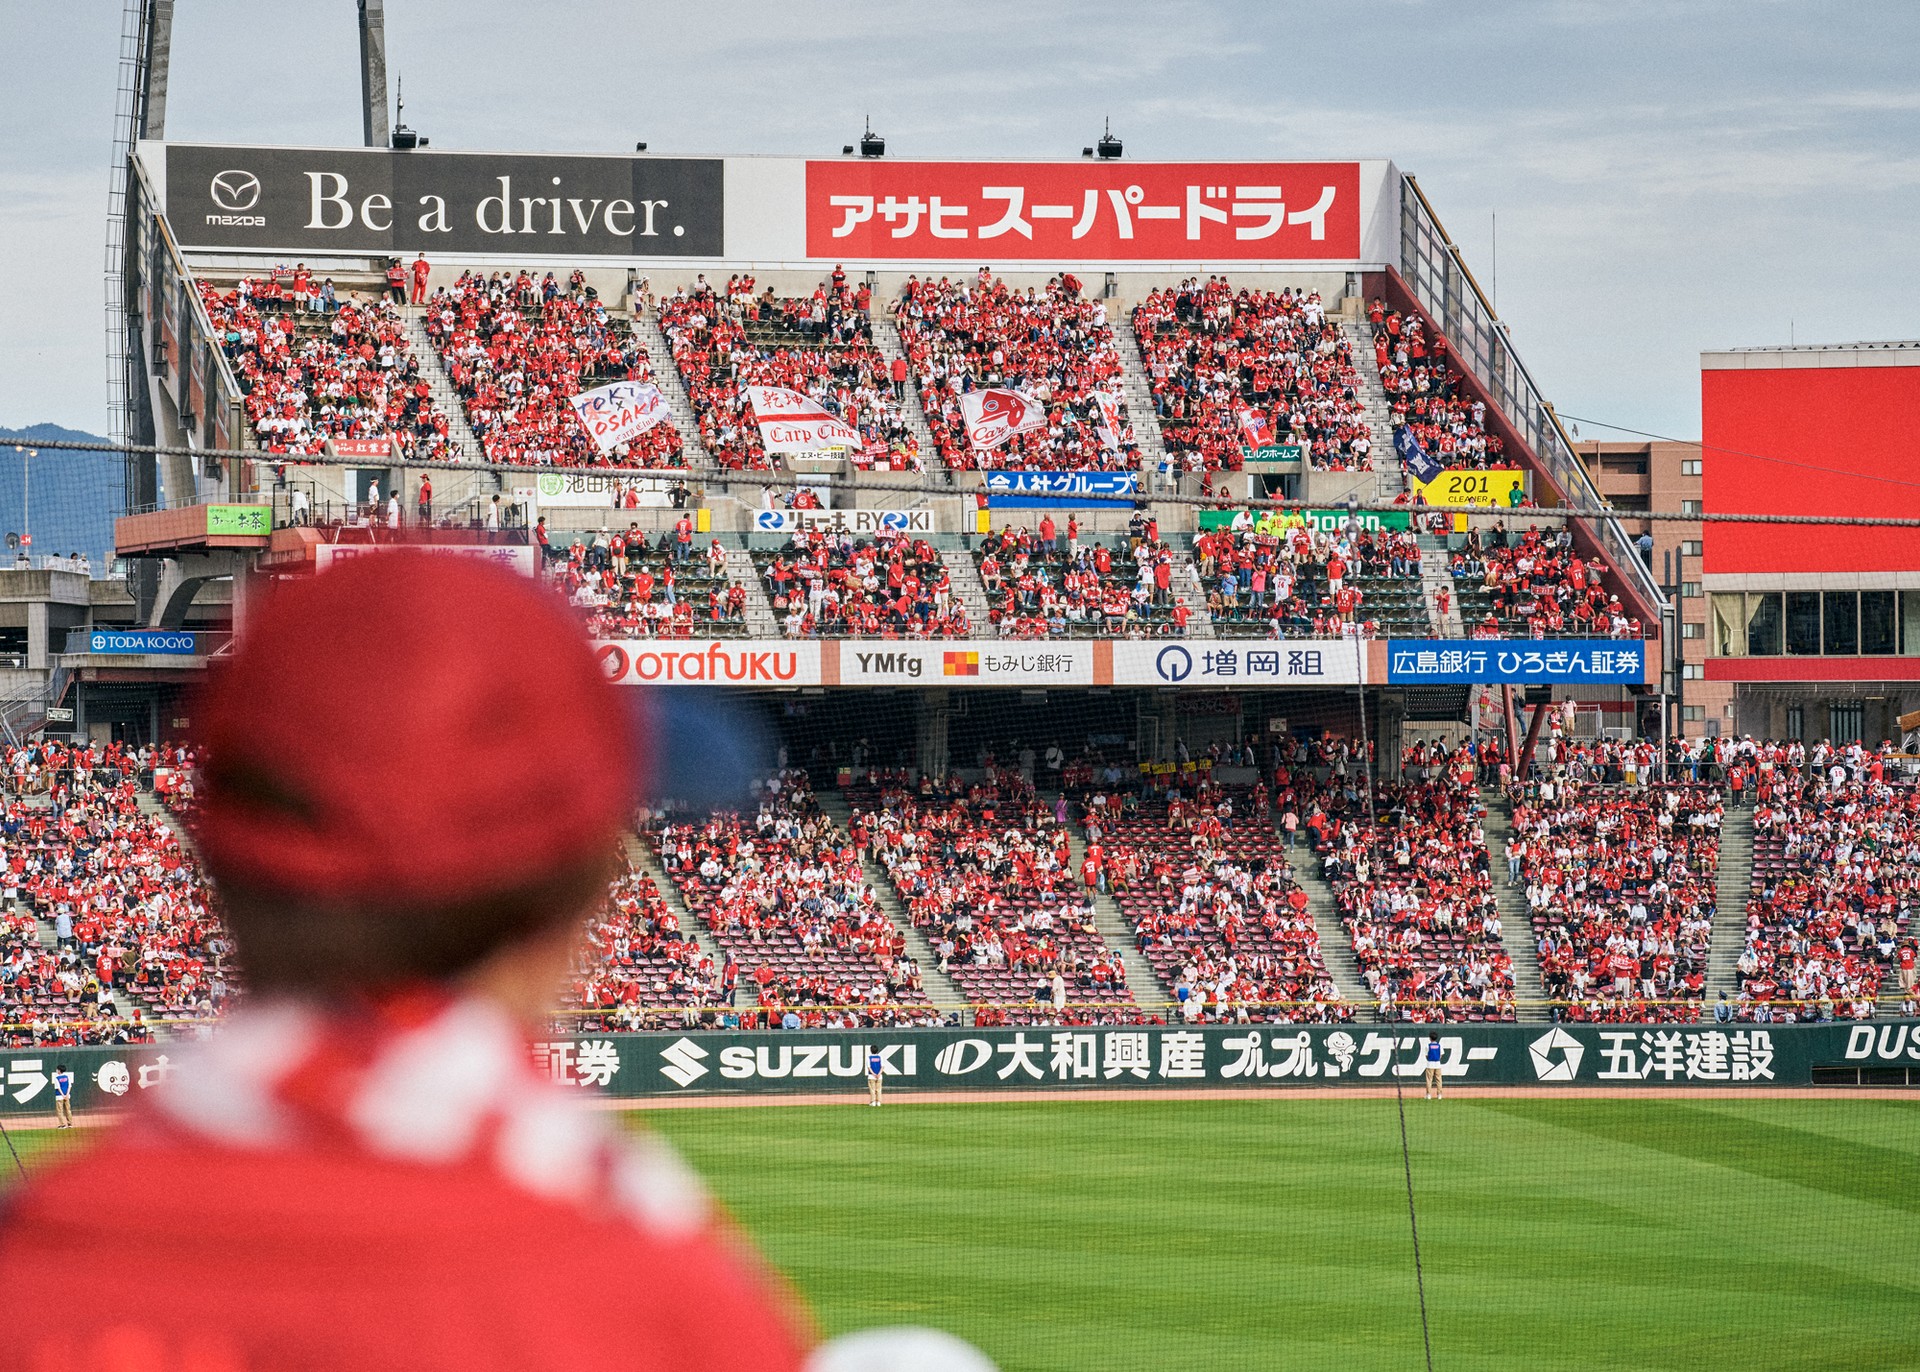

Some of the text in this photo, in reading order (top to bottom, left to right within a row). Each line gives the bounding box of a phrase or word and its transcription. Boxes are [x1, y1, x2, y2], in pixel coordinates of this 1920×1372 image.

[303, 171, 686, 237] Be a driver.
[594, 395, 660, 436] OSAKA
[636, 417, 656, 431] Club
[769, 426, 812, 444] Carp
[1448, 476, 1489, 493] 201
[107, 636, 194, 649] TODA KOGYO
[855, 653, 923, 678] YMfg
[985, 653, 1073, 674] もみじ銀行
[1201, 649, 1324, 677] 増岡組
[1392, 650, 1640, 676] 広島銀行 ひろぎん証券
[719, 1044, 917, 1078] SUZUKI
[996, 1032, 1207, 1081] 大和興産
[1596, 1030, 1776, 1081] 五洋建設
